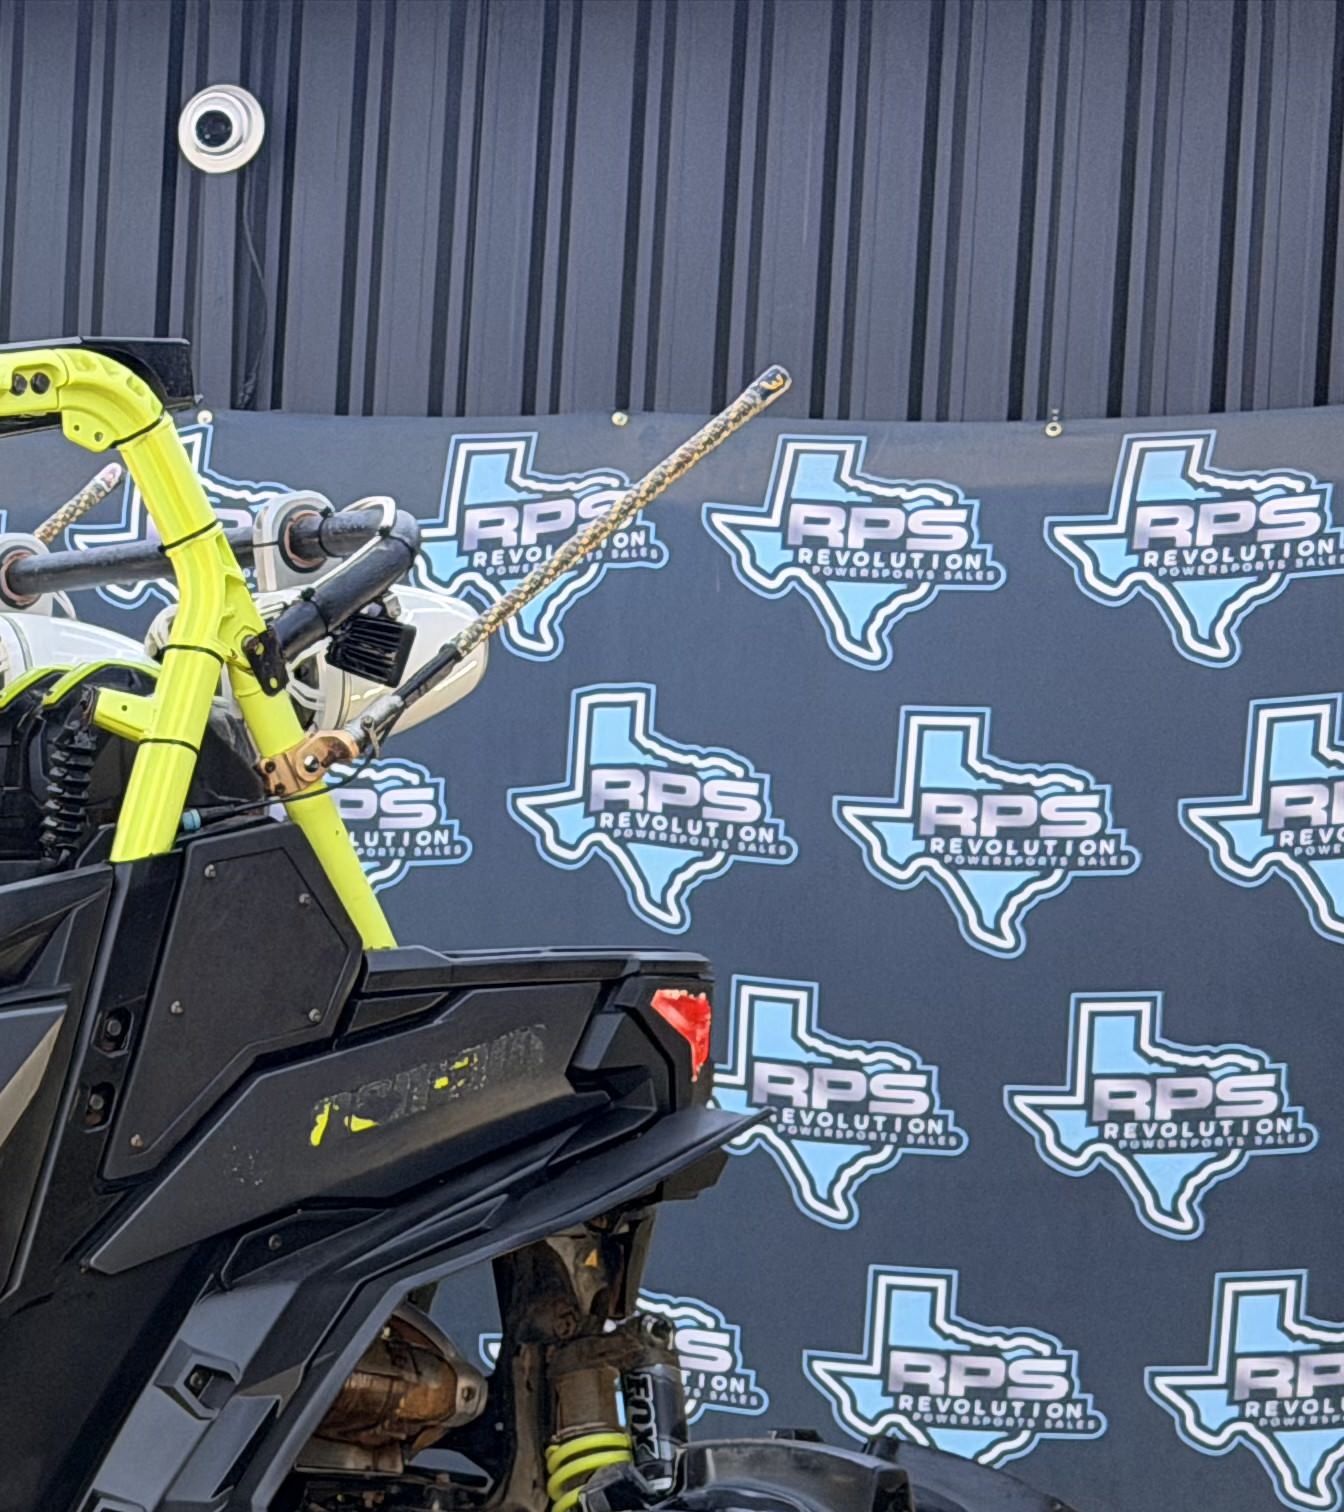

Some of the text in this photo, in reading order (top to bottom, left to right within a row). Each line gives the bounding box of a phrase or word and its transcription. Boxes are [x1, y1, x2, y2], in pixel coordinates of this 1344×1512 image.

[787, 504, 970, 550] RPS
[1132, 494, 1321, 549] RPS
[611, 547, 658, 560] SALES
[799, 550, 982, 570] REVOLUTION
[1144, 538, 1334, 568] REVOLUTION
[812, 565, 994, 581] POWERSPORTS SALES
[1159, 560, 1286, 577] POWERSPORTS
[589, 768, 762, 823] RPS
[600, 811, 774, 843] REVOLUTION
[919, 793, 1102, 838] RPS
[414, 845, 462, 857] SALES
[613, 828, 787, 856] POWERSPORTS SALES
[930, 838, 1115, 857] REVOLUTION
[944, 854, 1129, 868] POWERSPORTS SALES
[752, 1061, 930, 1116] RPS
[1092, 1074, 1276, 1122] RPS
[777, 1123, 957, 1146] POWERSPORTS SALES
[1104, 1118, 1293, 1140] REVOLUTION
[1118, 1133, 1307, 1150] POWERSPORTS SALES
[888, 1350, 1070, 1401] RPS
[709, 1391, 758, 1406] SALES
[899, 1394, 1082, 1422] REVOLUTION
[913, 1411, 1097, 1431] POWERSPORTS SALES
